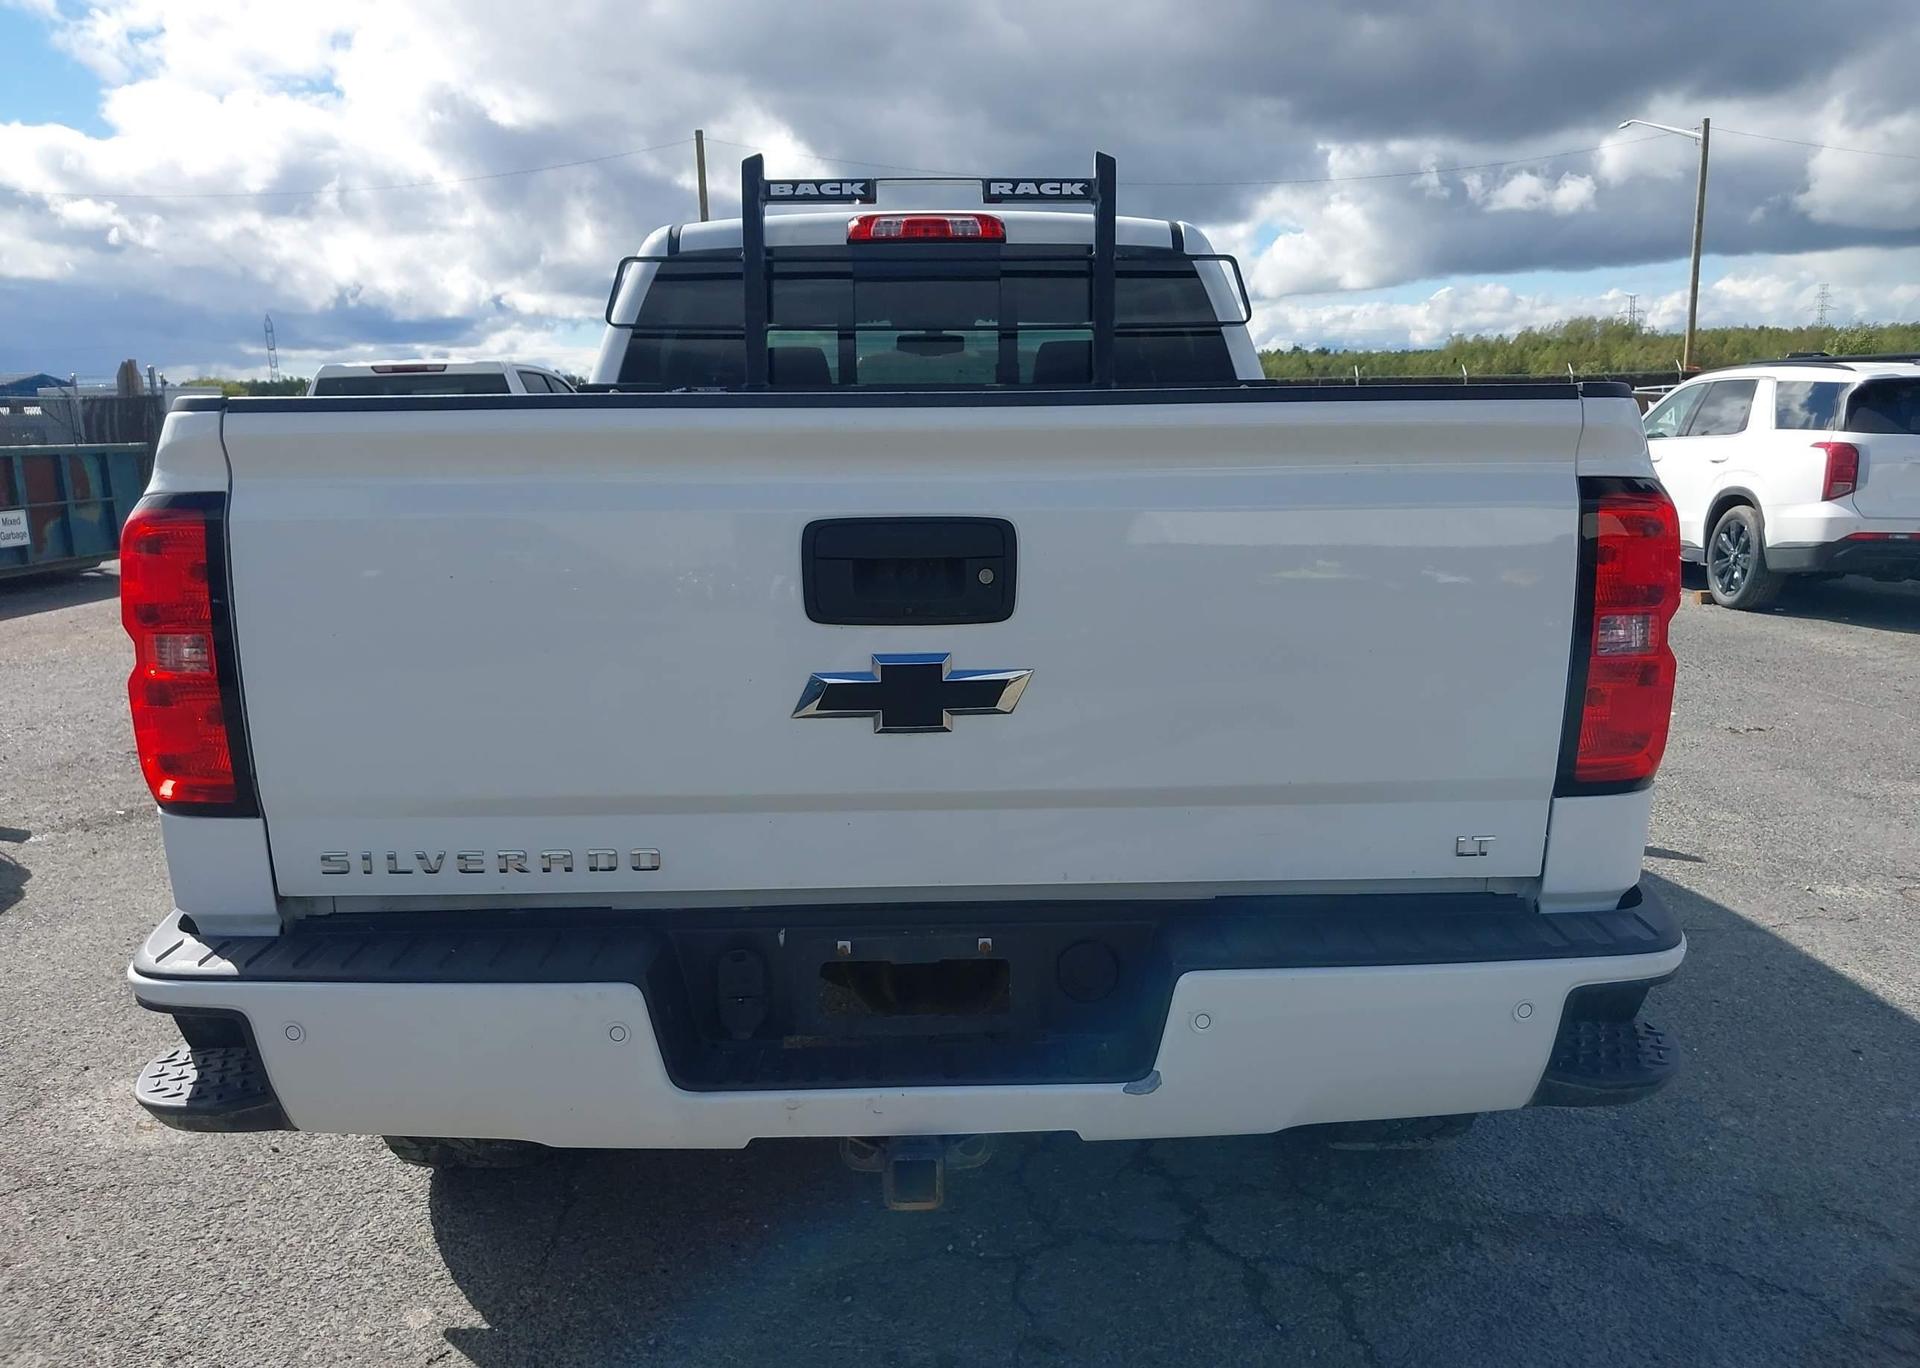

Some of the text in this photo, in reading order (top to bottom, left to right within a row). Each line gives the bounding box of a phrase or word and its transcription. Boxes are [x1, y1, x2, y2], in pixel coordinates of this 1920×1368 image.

[769, 181, 1086, 196] BACK RACK
[1, 517, 21, 526] Mixed
[0, 530, 28, 541] Garbage
[1456, 834, 1497, 857] LT
[320, 847, 661, 875] SILVERADO
